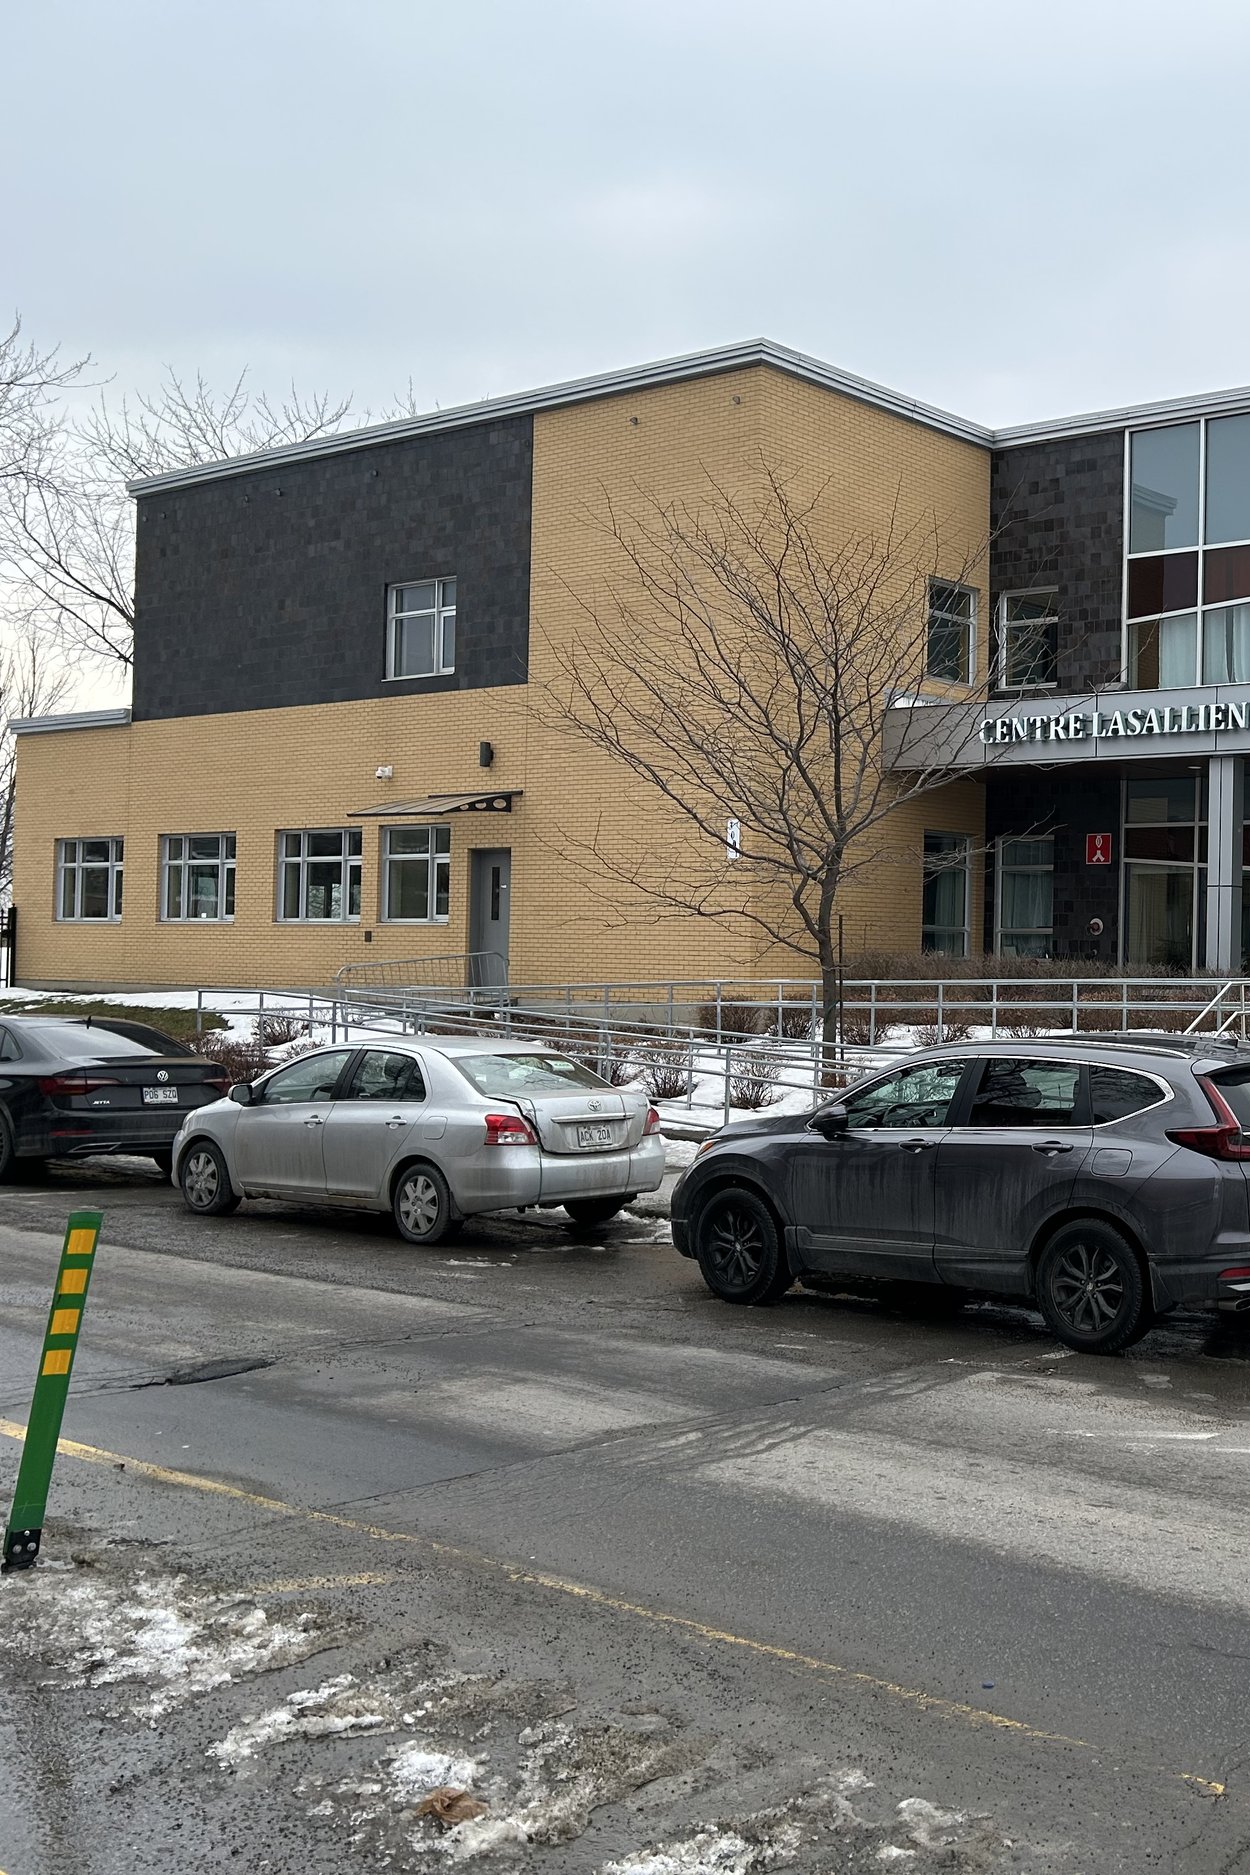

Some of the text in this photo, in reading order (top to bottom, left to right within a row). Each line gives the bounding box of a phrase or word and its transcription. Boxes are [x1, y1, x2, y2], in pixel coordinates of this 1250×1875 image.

[979, 713, 1084, 744] CENTRE
[1091, 701, 1249, 738] LASALLIEN
[580, 1130, 594, 1142] ACK
